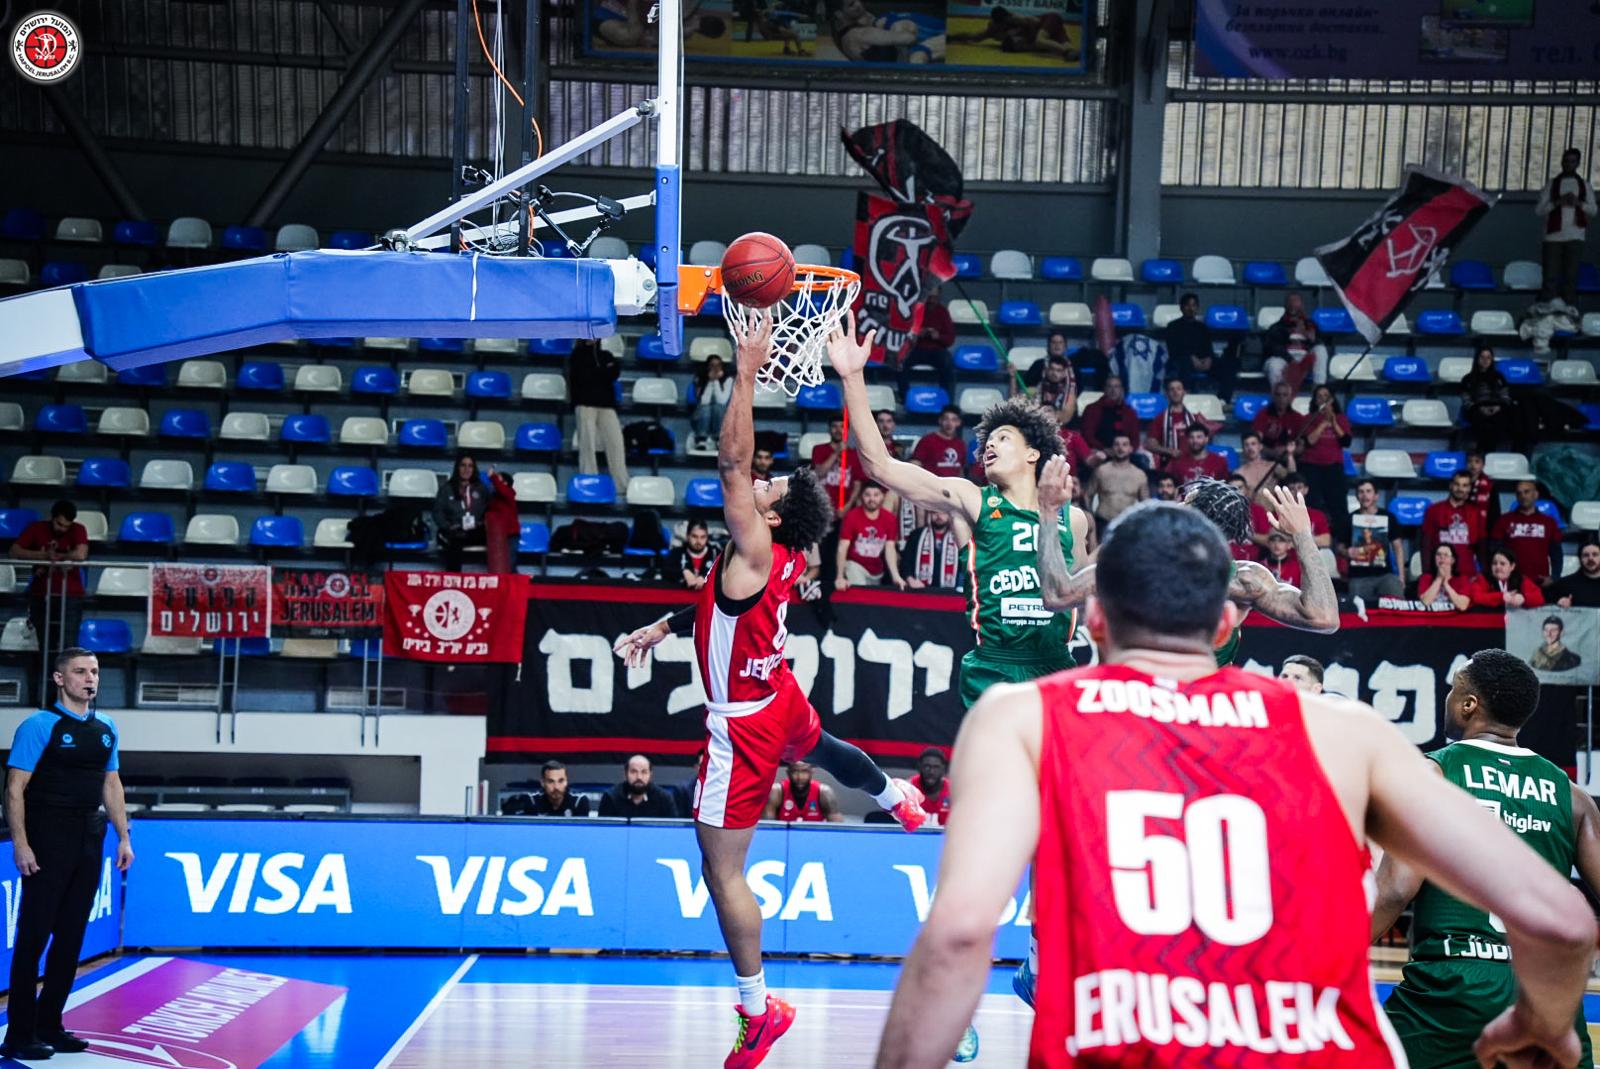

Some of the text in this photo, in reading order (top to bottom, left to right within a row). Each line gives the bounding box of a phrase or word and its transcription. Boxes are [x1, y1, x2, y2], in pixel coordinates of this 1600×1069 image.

[283, 571, 372, 598] HAPEL
[283, 600, 376, 622] JERUSALEM
[161, 609, 259, 632] ירושלים
[539, 612, 953, 720] ירולים
[1074, 679, 1269, 729] ZOOSMAN
[1463, 764, 1558, 806] LEMAR
[1503, 810, 1551, 833] triglav
[165, 852, 353, 915] VISA
[416, 855, 595, 917] VISA
[656, 858, 834, 922] VSA
[1105, 789, 1274, 946] 50
[1, 856, 112, 950] VA
[1065, 968, 1356, 1058] ERUSALEM
